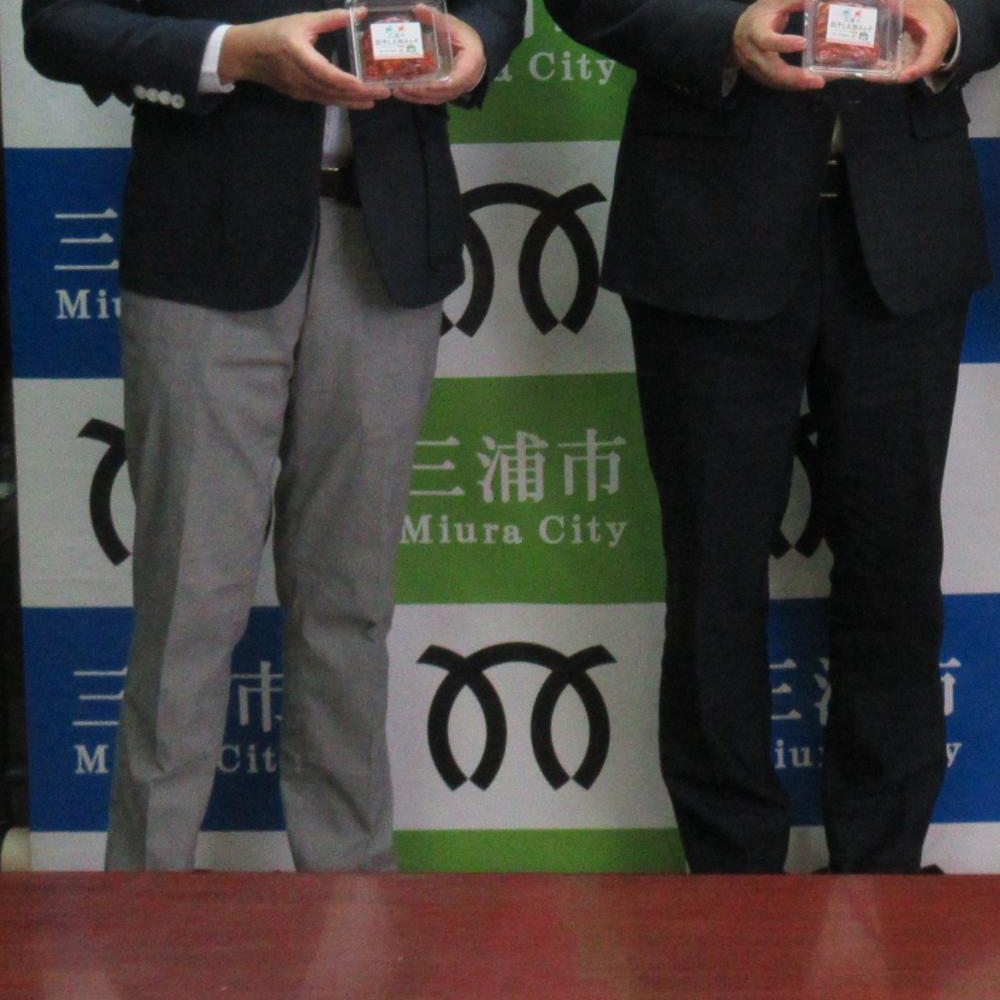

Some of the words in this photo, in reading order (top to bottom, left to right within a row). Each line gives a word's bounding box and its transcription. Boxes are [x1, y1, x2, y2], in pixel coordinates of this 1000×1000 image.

[528, 51, 617, 86] City
[409, 428, 627, 503] 三浦市
[400, 513, 523, 545] Miura
[538, 513, 628, 547] City
[217, 744, 277, 773] Cit
